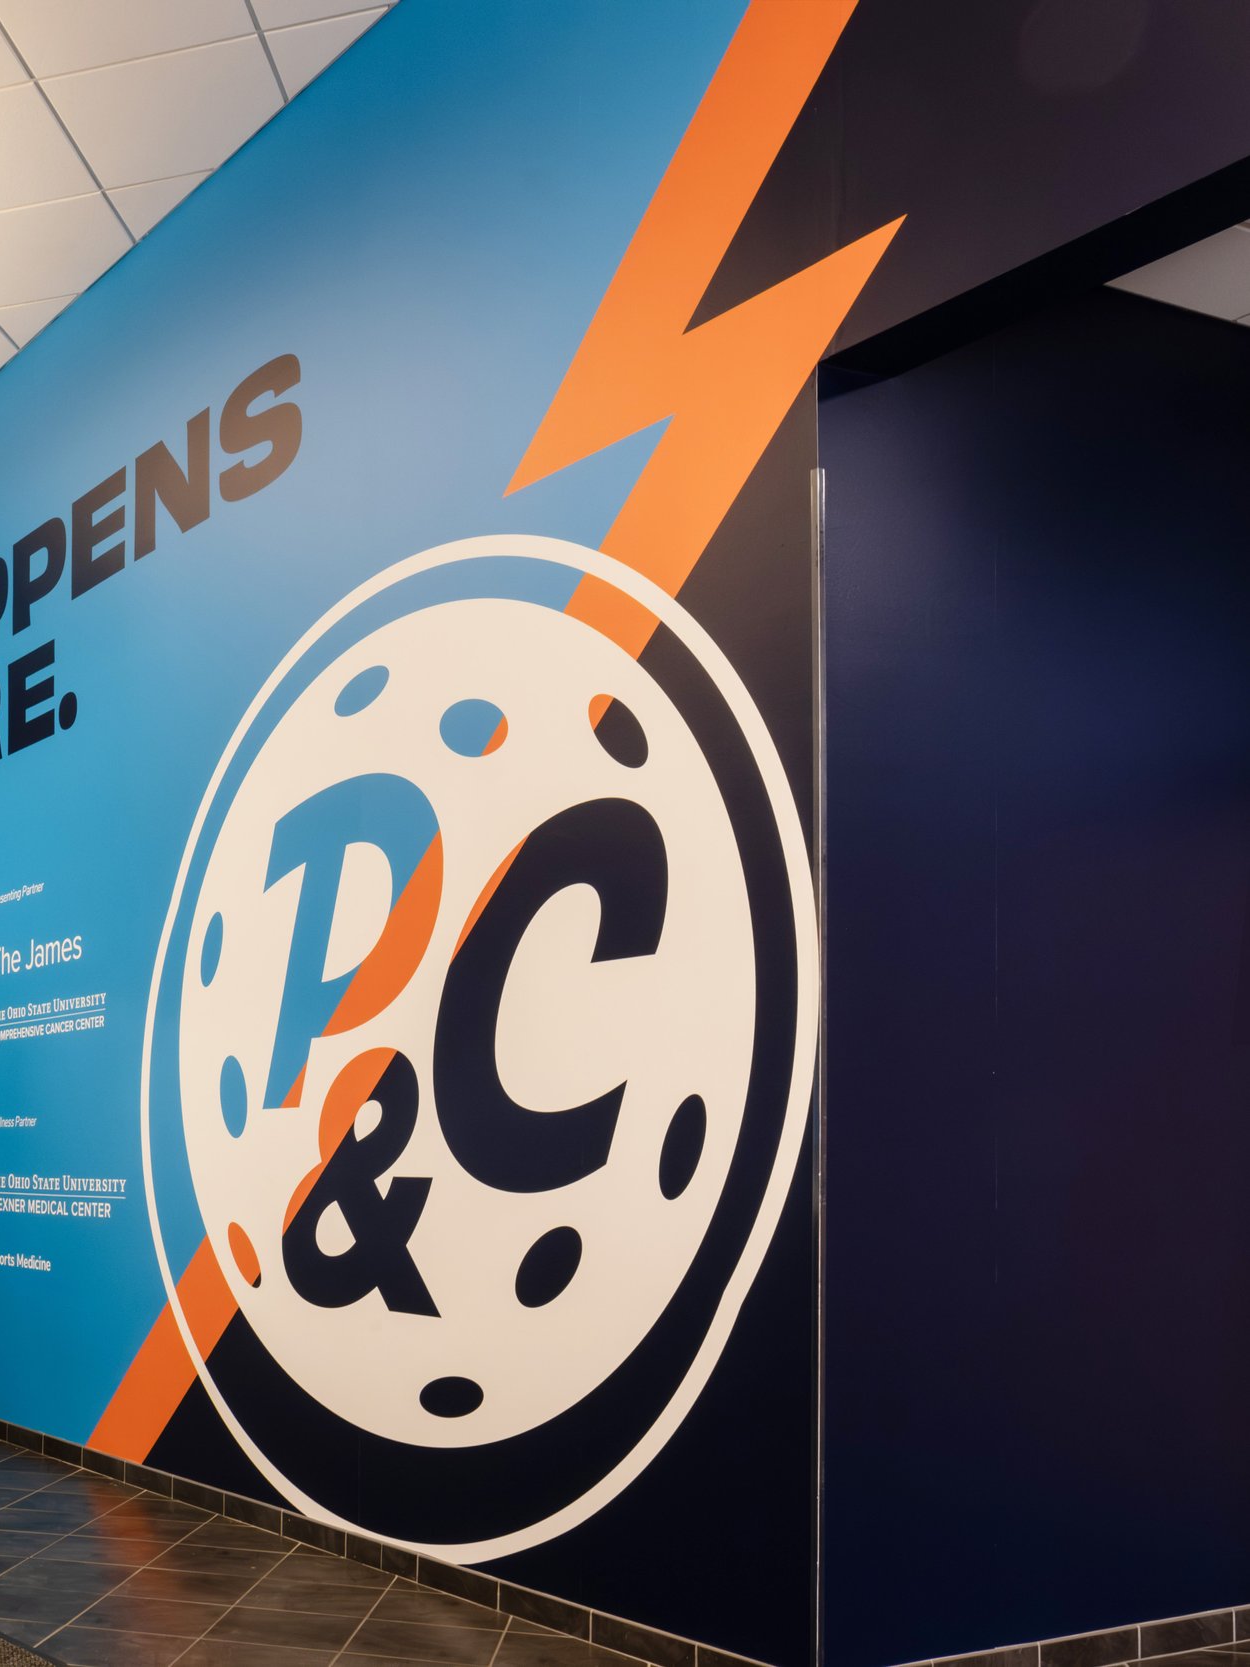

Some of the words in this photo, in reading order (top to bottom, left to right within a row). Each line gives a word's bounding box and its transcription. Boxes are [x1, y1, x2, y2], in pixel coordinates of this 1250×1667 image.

[22, 882, 45, 897] Partner
[25, 935, 82, 970] James
[7, 1006, 27, 1020] OHIO
[28, 1003, 52, 1016] STATE
[53, 992, 107, 1012] UNIVERSITY
[45, 1019, 74, 1035] CANCER
[75, 1015, 105, 1031] CENTER
[15, 1115, 37, 1127] Partner
[8, 1173, 30, 1189] OHIO
[32, 1174, 60, 1190] STATE
[62, 1175, 126, 1193] UNIVERSITY
[27, 1199, 68, 1216] MEDICAL
[71, 1201, 111, 1218] CENTER
[16, 1253, 51, 1272] Medicine
